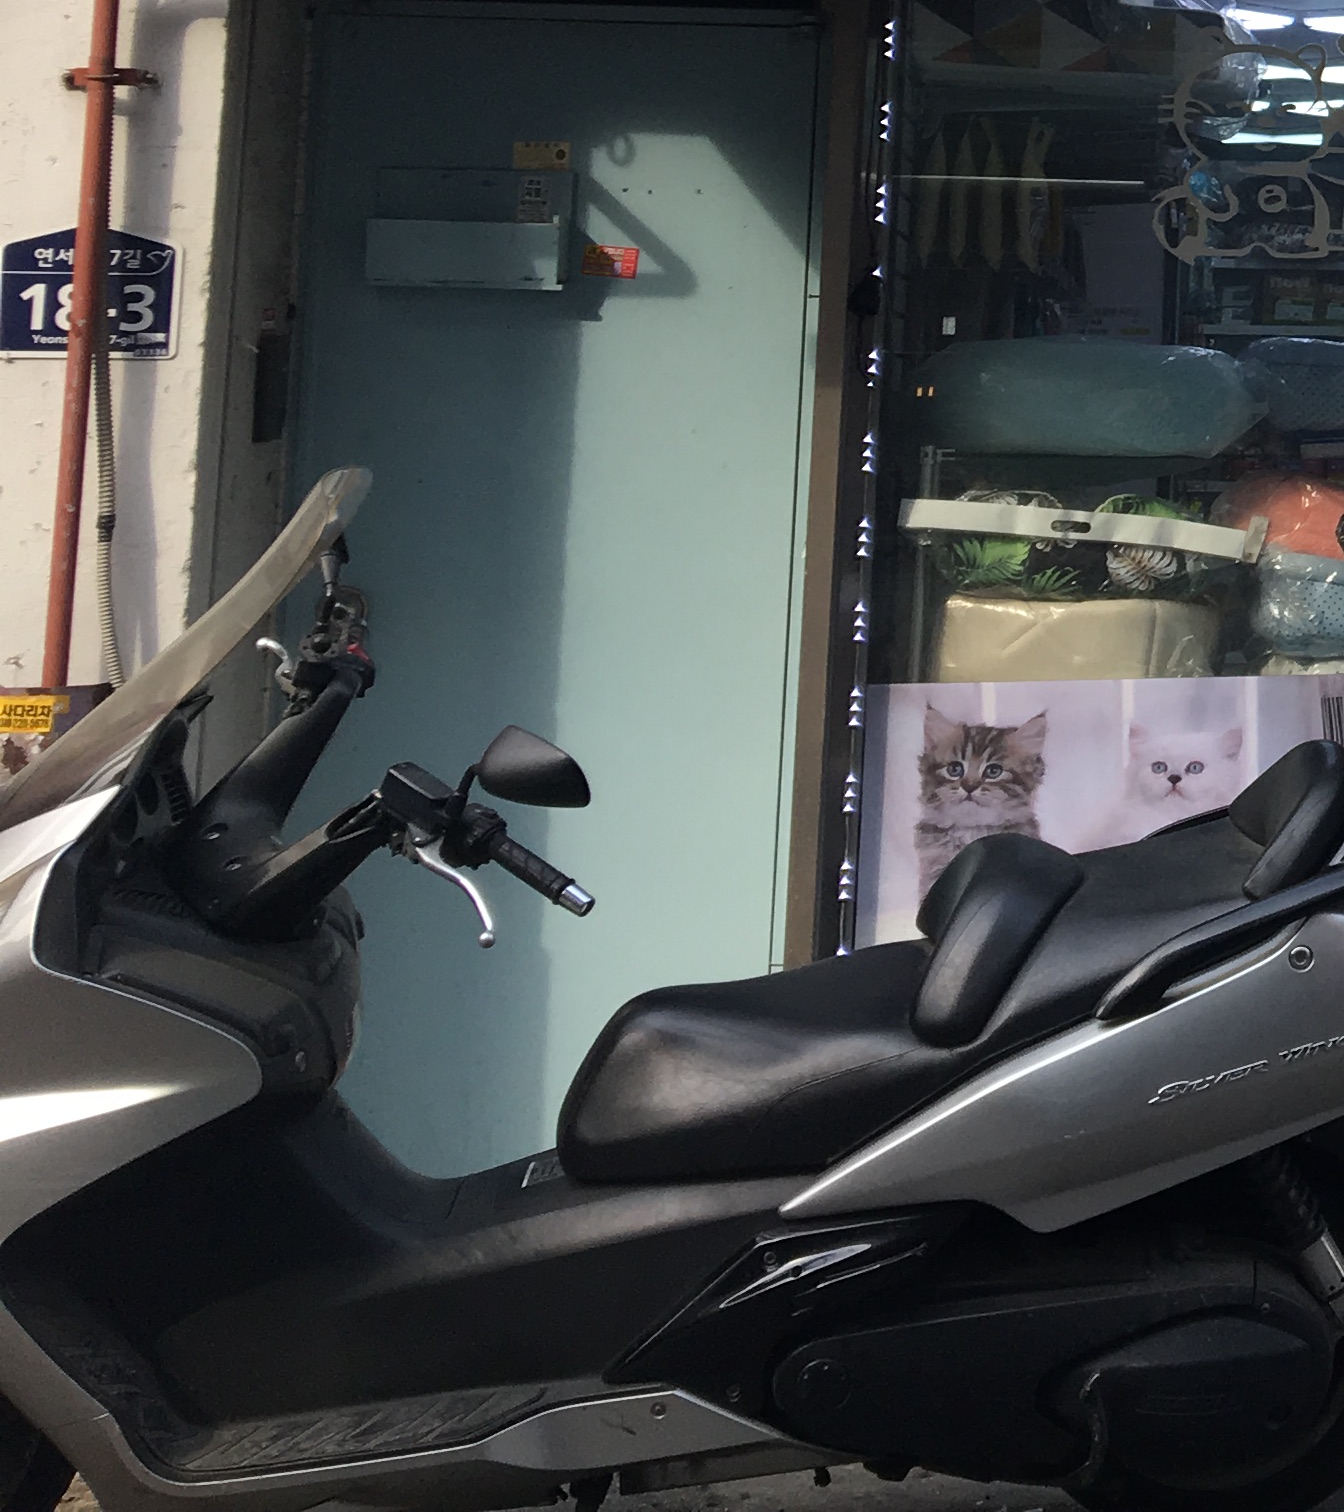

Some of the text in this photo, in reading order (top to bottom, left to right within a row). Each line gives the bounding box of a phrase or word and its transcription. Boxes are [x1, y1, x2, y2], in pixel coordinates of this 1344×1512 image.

[34, 247, 142, 269] 연서7길
[19, 283, 156, 332] 18-3
[1, 705, 53, 718] 사다리차
